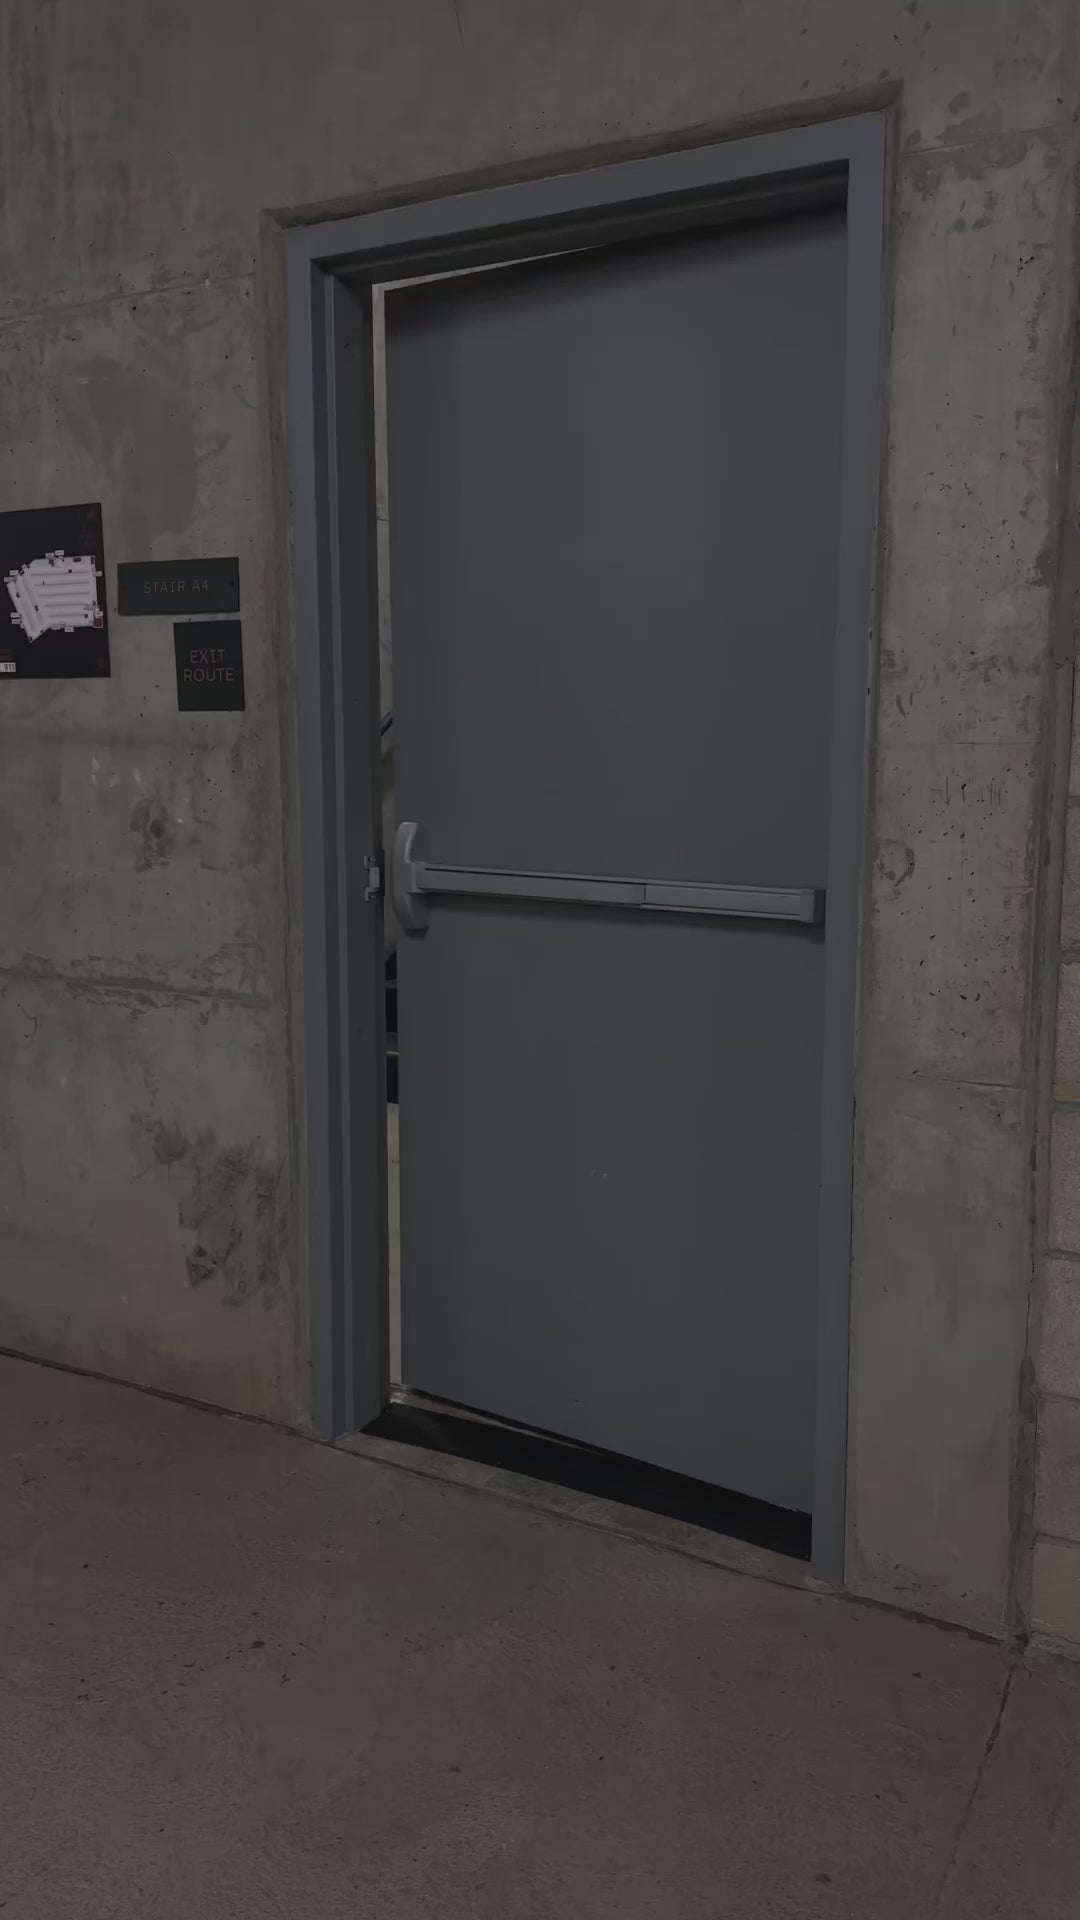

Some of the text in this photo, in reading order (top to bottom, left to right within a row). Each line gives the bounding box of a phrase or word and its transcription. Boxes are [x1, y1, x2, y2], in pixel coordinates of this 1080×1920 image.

[143, 578, 210, 595] STAIR A4
[189, 648, 226, 665] EXIT
[183, 667, 235, 683] ROUTE
